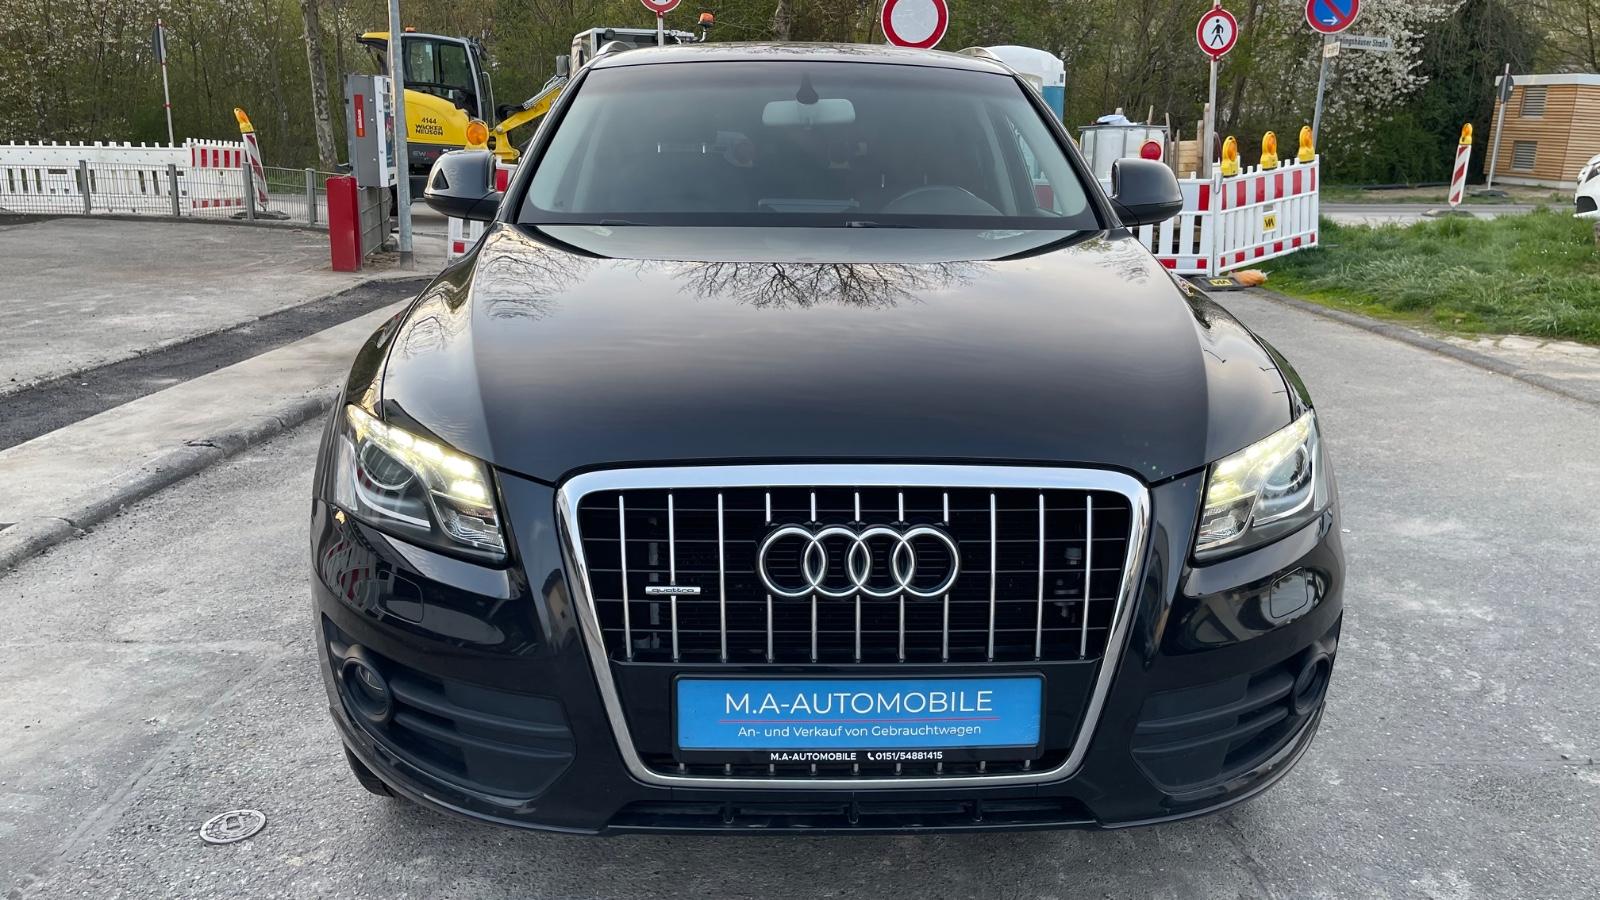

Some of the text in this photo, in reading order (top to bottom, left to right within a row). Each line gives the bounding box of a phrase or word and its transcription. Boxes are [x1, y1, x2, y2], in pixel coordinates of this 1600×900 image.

[1372, 39, 1388, 48] Straße
[725, 690, 993, 714] M.A-AUTOMOBILE
[738, 724, 981, 738] An- und Verkauf von Gebrauchtwagen
[770, 751, 943, 761] M.A-AUTOMOBILE 0151/54881415
